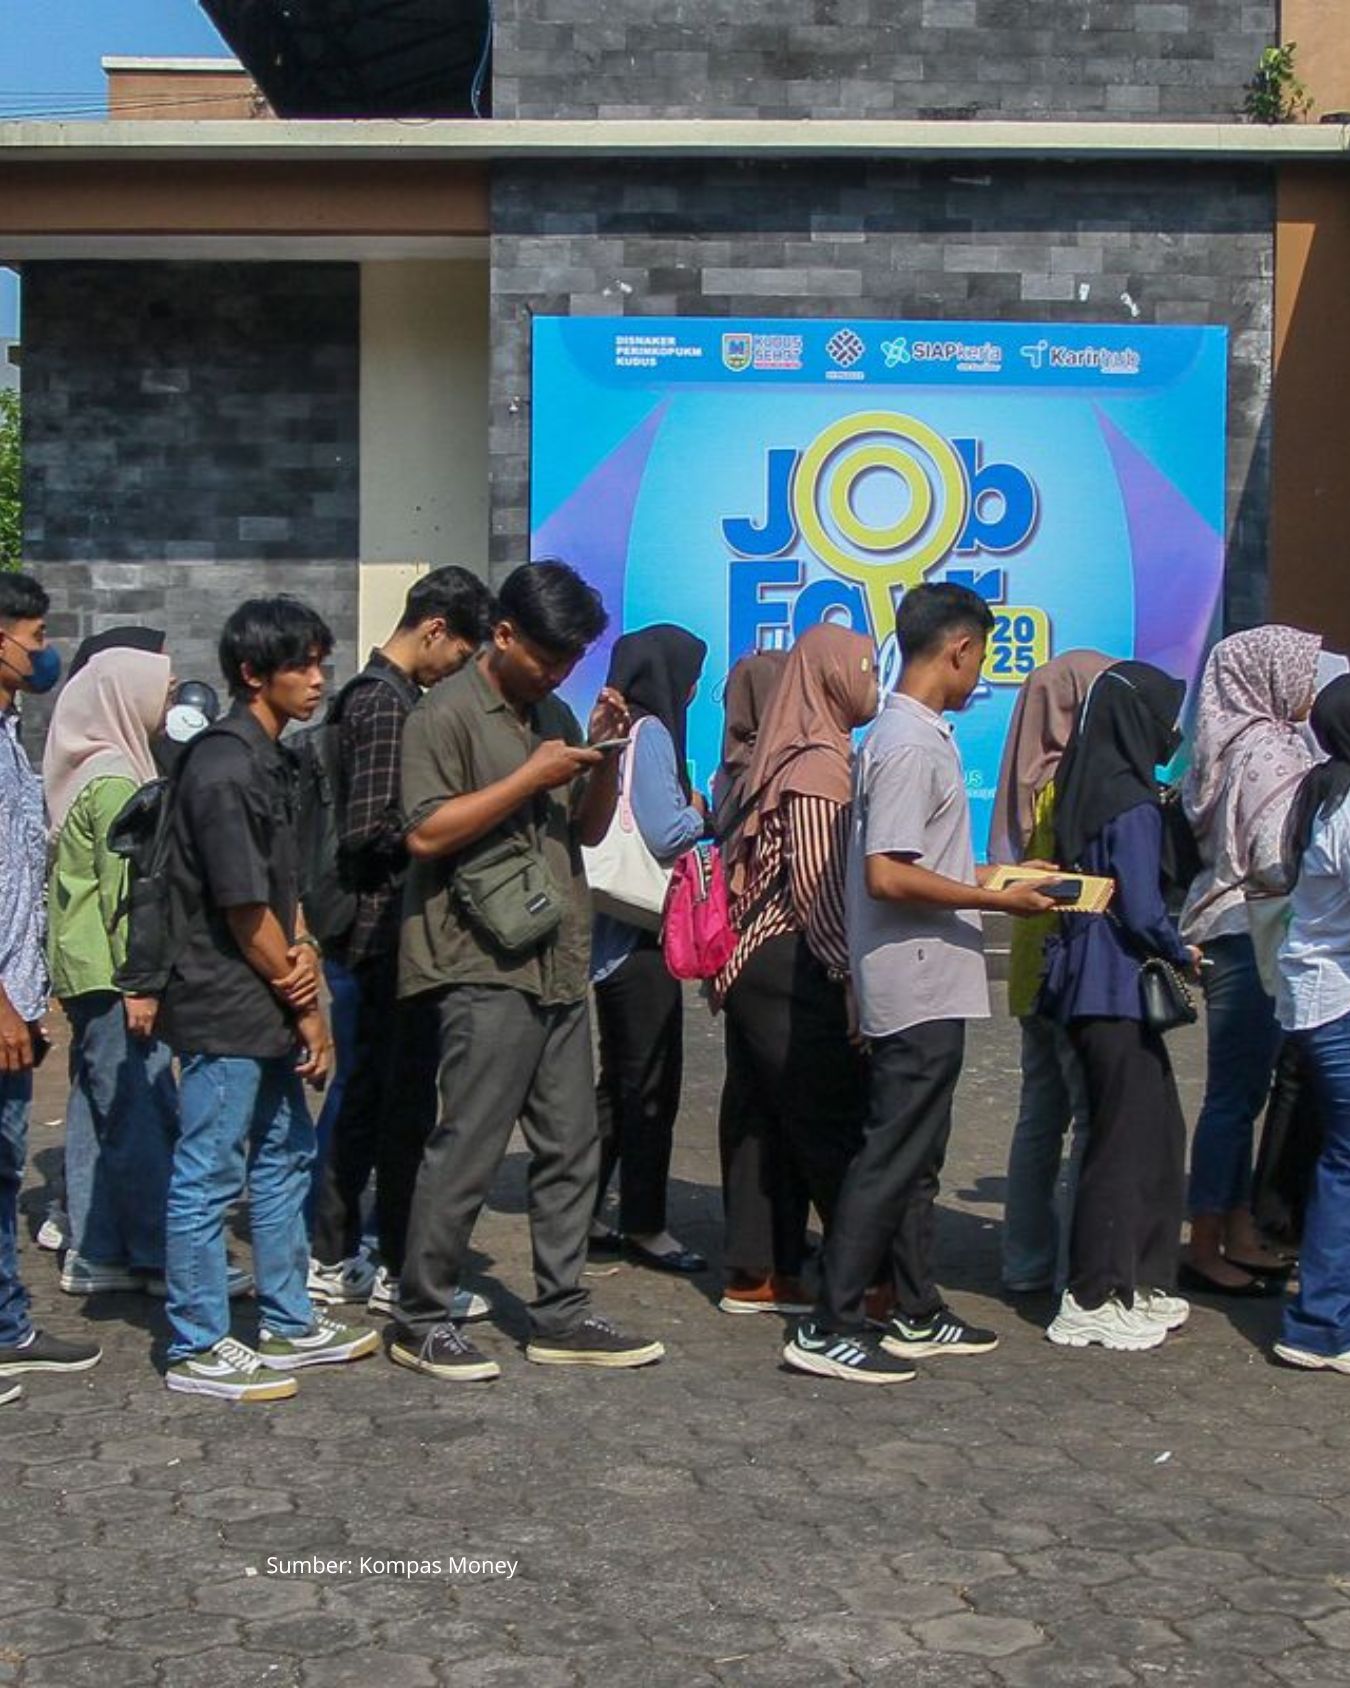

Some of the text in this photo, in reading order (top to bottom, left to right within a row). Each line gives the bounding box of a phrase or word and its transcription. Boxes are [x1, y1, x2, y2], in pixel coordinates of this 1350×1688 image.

[615, 335, 676, 345] DISNAKER
[615, 357, 657, 367] KUDUS
[992, 615, 1035, 644] 20
[992, 645, 1036, 673] 25
